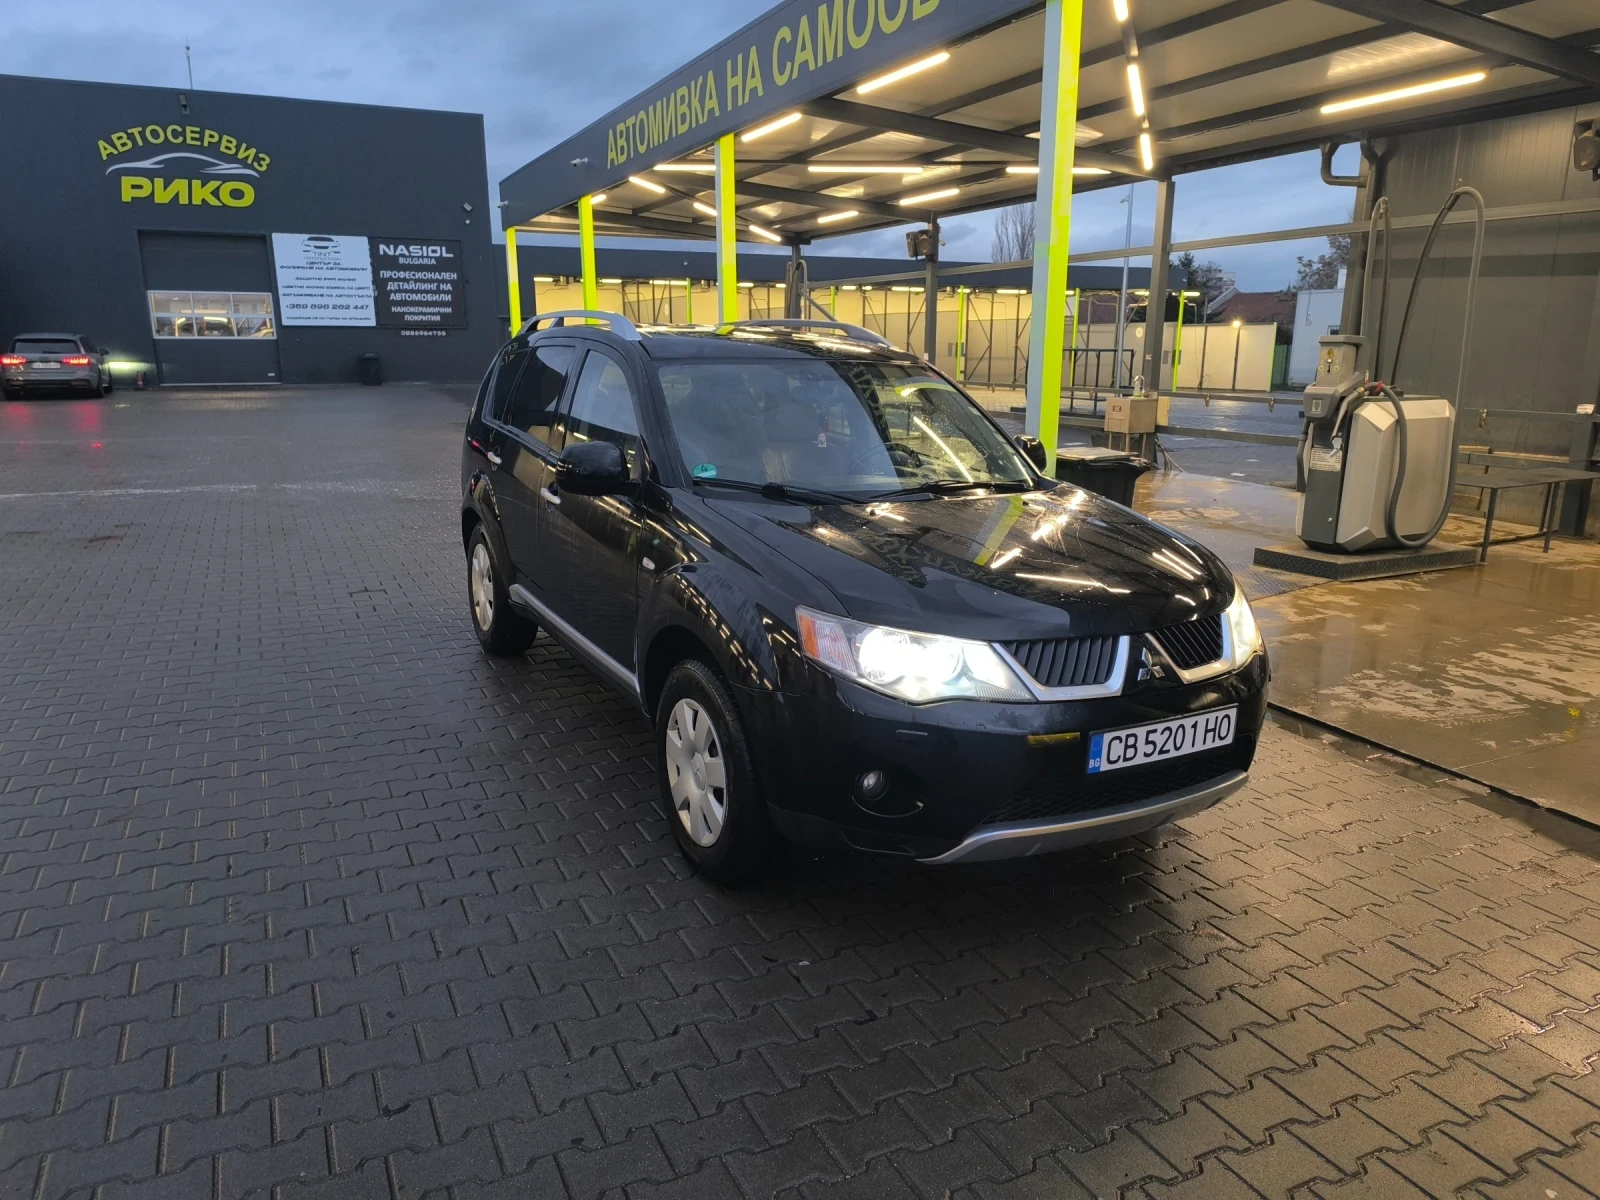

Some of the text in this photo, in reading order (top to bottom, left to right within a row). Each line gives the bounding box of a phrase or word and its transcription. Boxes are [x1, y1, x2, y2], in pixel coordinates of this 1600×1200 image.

[607, 69, 720, 170] АВТОМИВКА
[726, 44, 764, 112] НА
[97, 124, 271, 172] АВТОСЕРВИЗ
[120, 175, 255, 208] РИКО
[378, 243, 454, 258] NASIOL
[398, 257, 436, 265] BULGARIA
[380, 270, 457, 280] ПРОФЕСИОНАЛЕН
[386, 280, 453, 291] ДЕТАЙЛИНГ НА
[389, 292, 452, 302] АВТОМОБИЛИ
[1106, 713, 1232, 765] CB 5201 HO
[1089, 758, 1101, 769] BG
